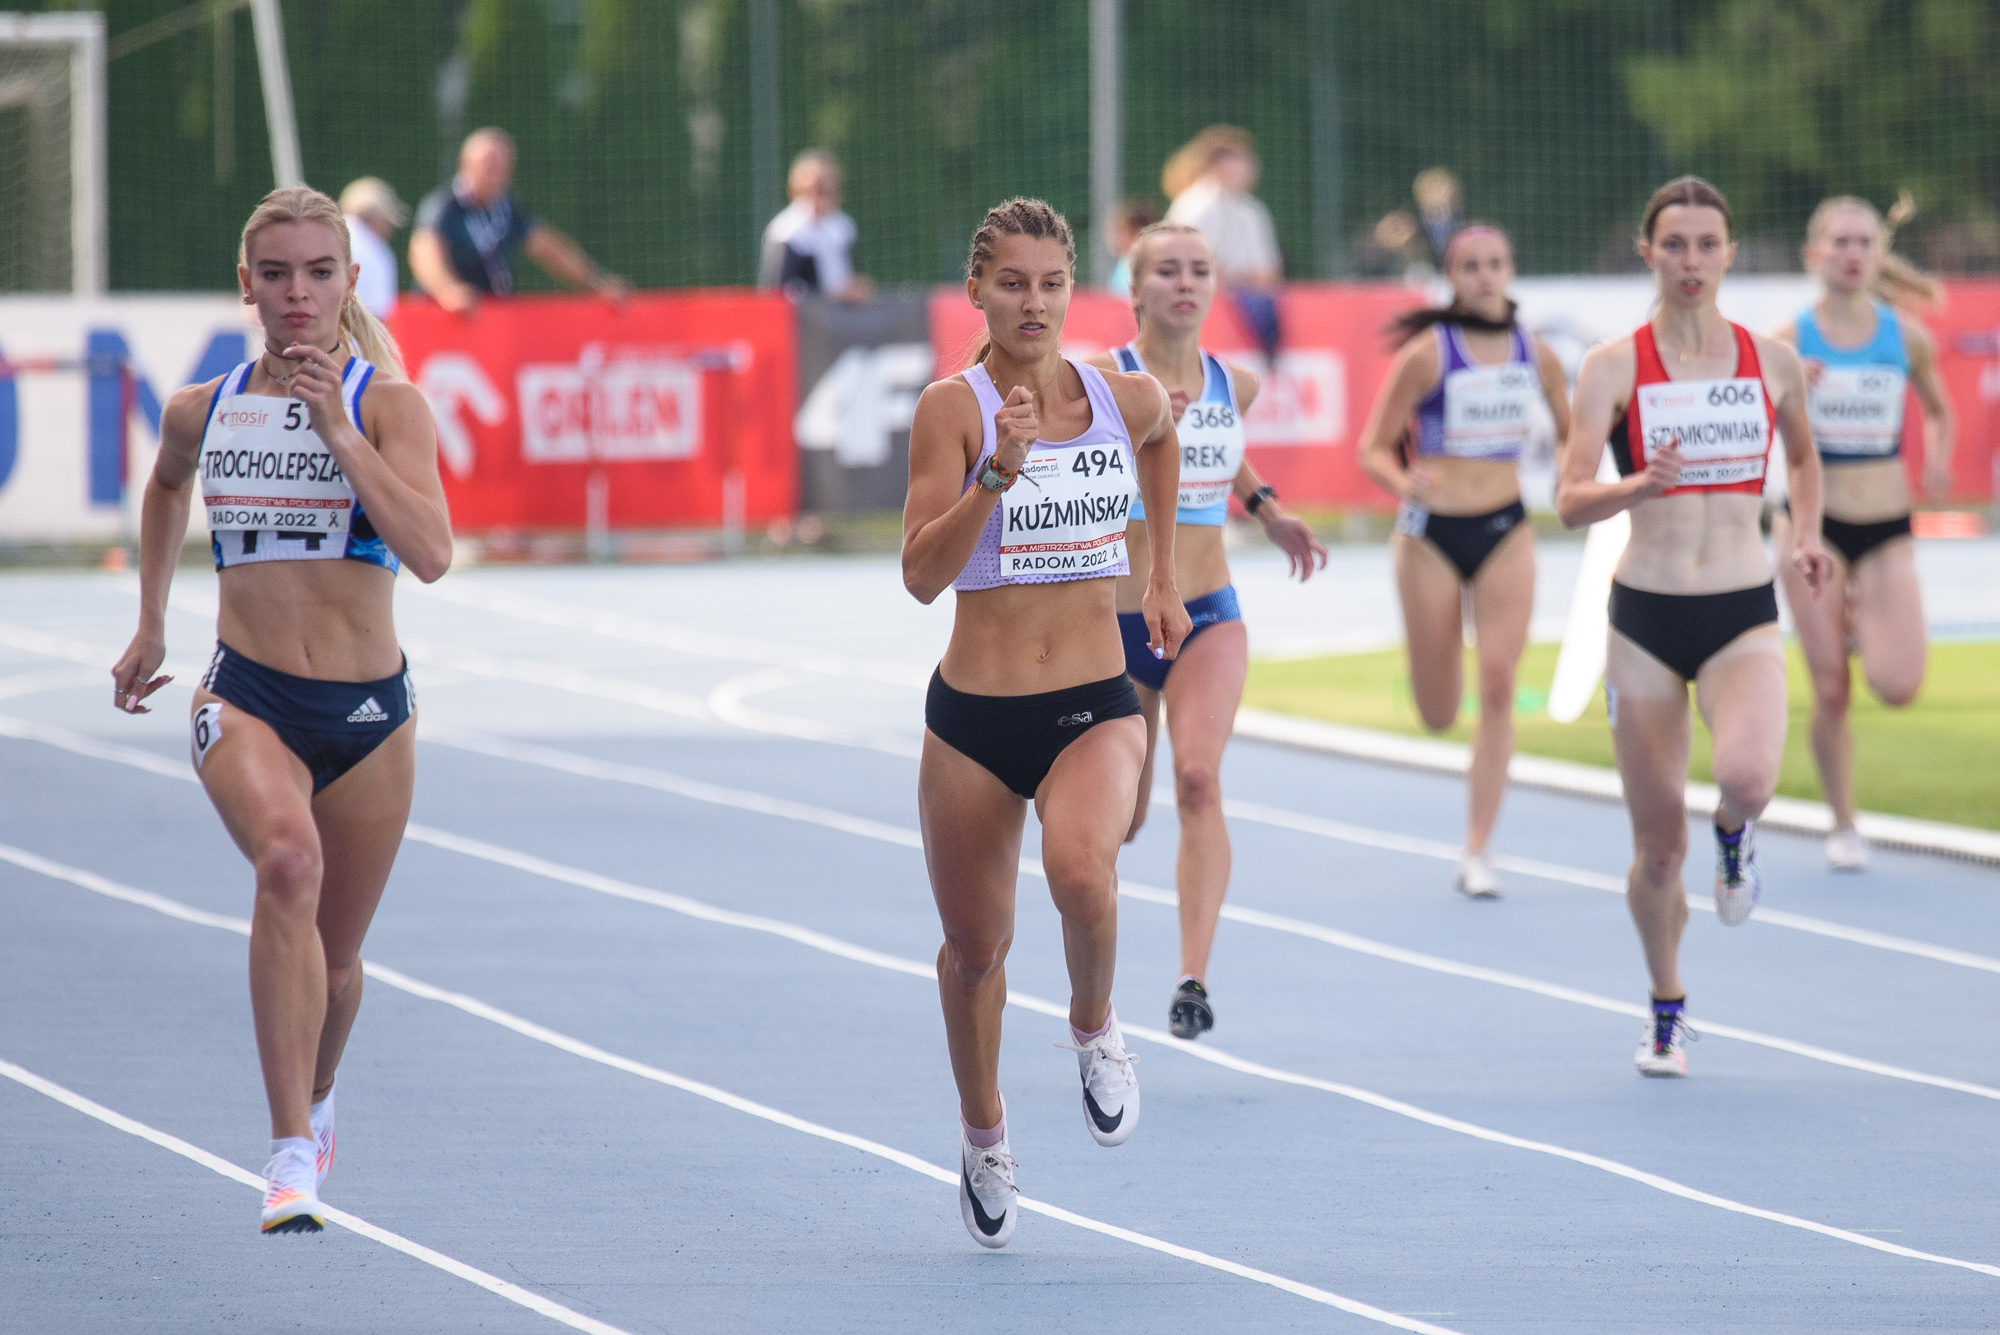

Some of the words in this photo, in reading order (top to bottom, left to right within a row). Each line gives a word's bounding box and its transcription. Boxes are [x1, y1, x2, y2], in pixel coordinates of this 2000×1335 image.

[1708, 385, 1755, 406] 606
[1190, 407, 1234, 429] 368
[205, 450, 343, 482] TROCHOLEPSZA
[1072, 449, 1124, 478] 494
[289, 500, 324, 508] POLSKI
[1009, 492, 1129, 532] KUŹMIŃSKA
[212, 511, 268, 526] RADOM
[273, 513, 317, 527] 2022
[1004, 546, 1028, 554] PZLA
[1029, 541, 1092, 552] MISTRZOSTWA
[1092, 537, 1110, 548] POLSKI
[1012, 556, 1076, 570] RADOM
[1081, 550, 1108, 568] 2022
[347, 712, 389, 722] adidas
[195, 707, 209, 752] 6
